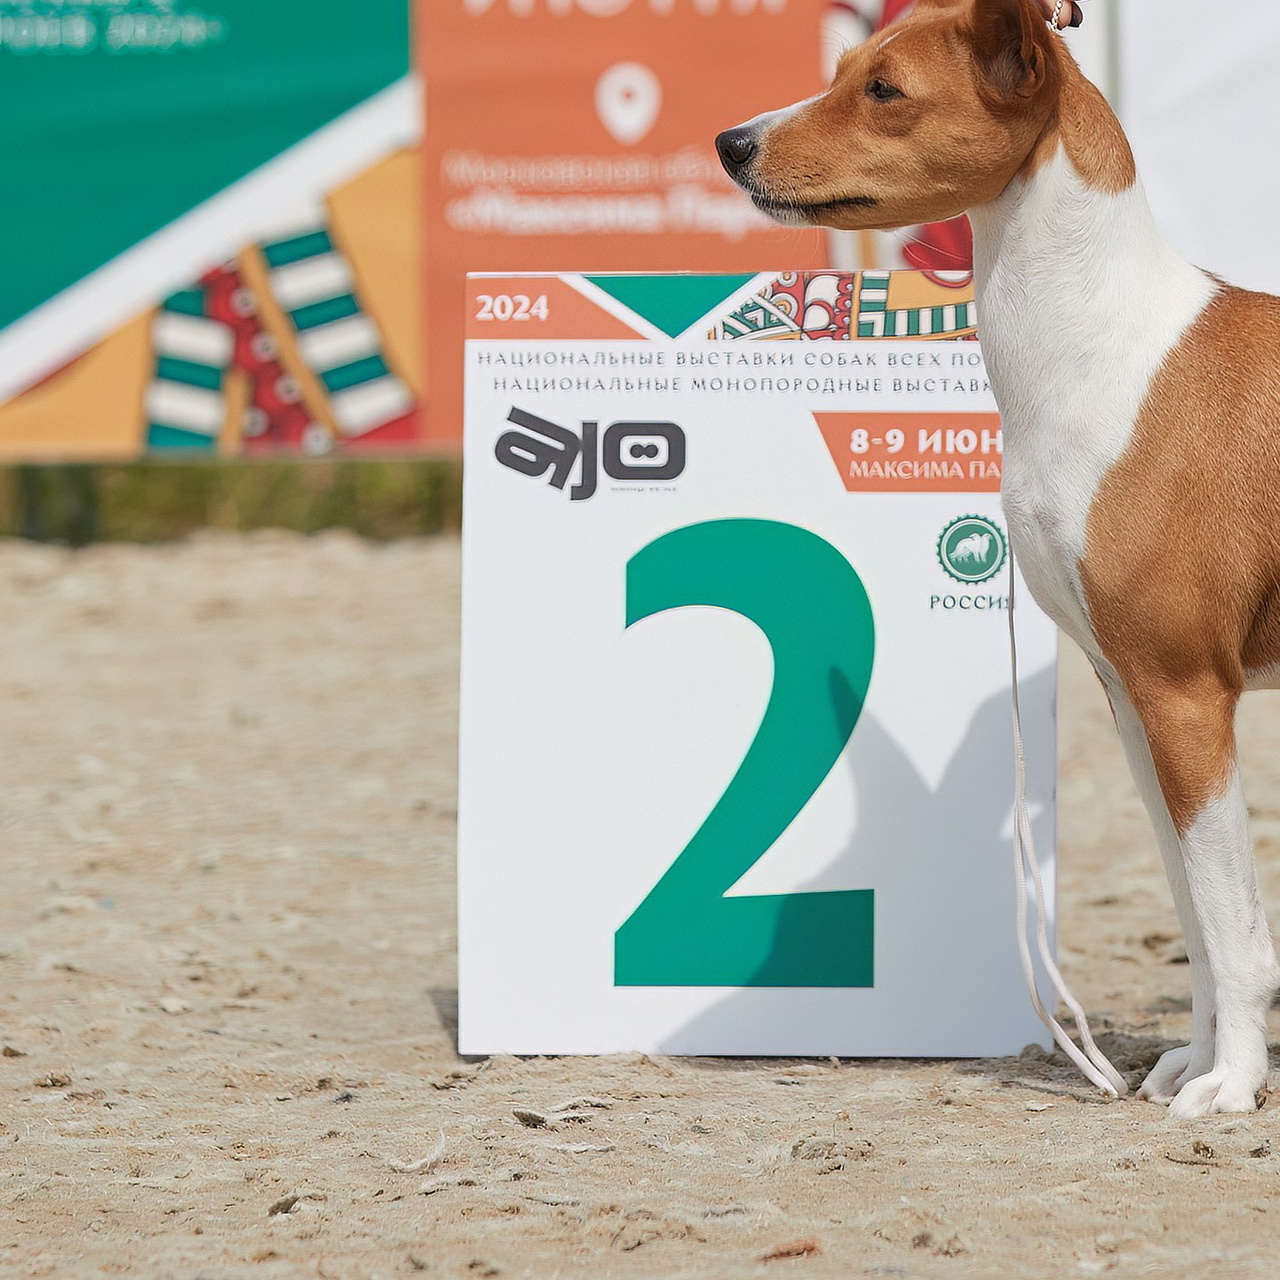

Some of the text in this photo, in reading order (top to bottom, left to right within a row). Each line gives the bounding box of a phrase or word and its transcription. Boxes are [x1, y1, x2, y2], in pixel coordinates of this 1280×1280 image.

[475, 294, 549, 320] 2024
[478, 352, 666, 367] НАЦИОНАЛЬНЫЕ
[676, 352, 794, 367] ВЫСТАВКИ
[804, 352, 877, 367] СОБАК
[887, 352, 941, 367] ВСЕХ
[493, 377, 681, 393] НАЦИОНАЛЬНЫЕ
[691, 377, 882, 395] МОНОПОРОДНЫЕ
[850, 428, 1003, 454] 8-9 ИЮН
[850, 460, 965, 480] МАКСИМА
[614, 517, 875, 988] 2
